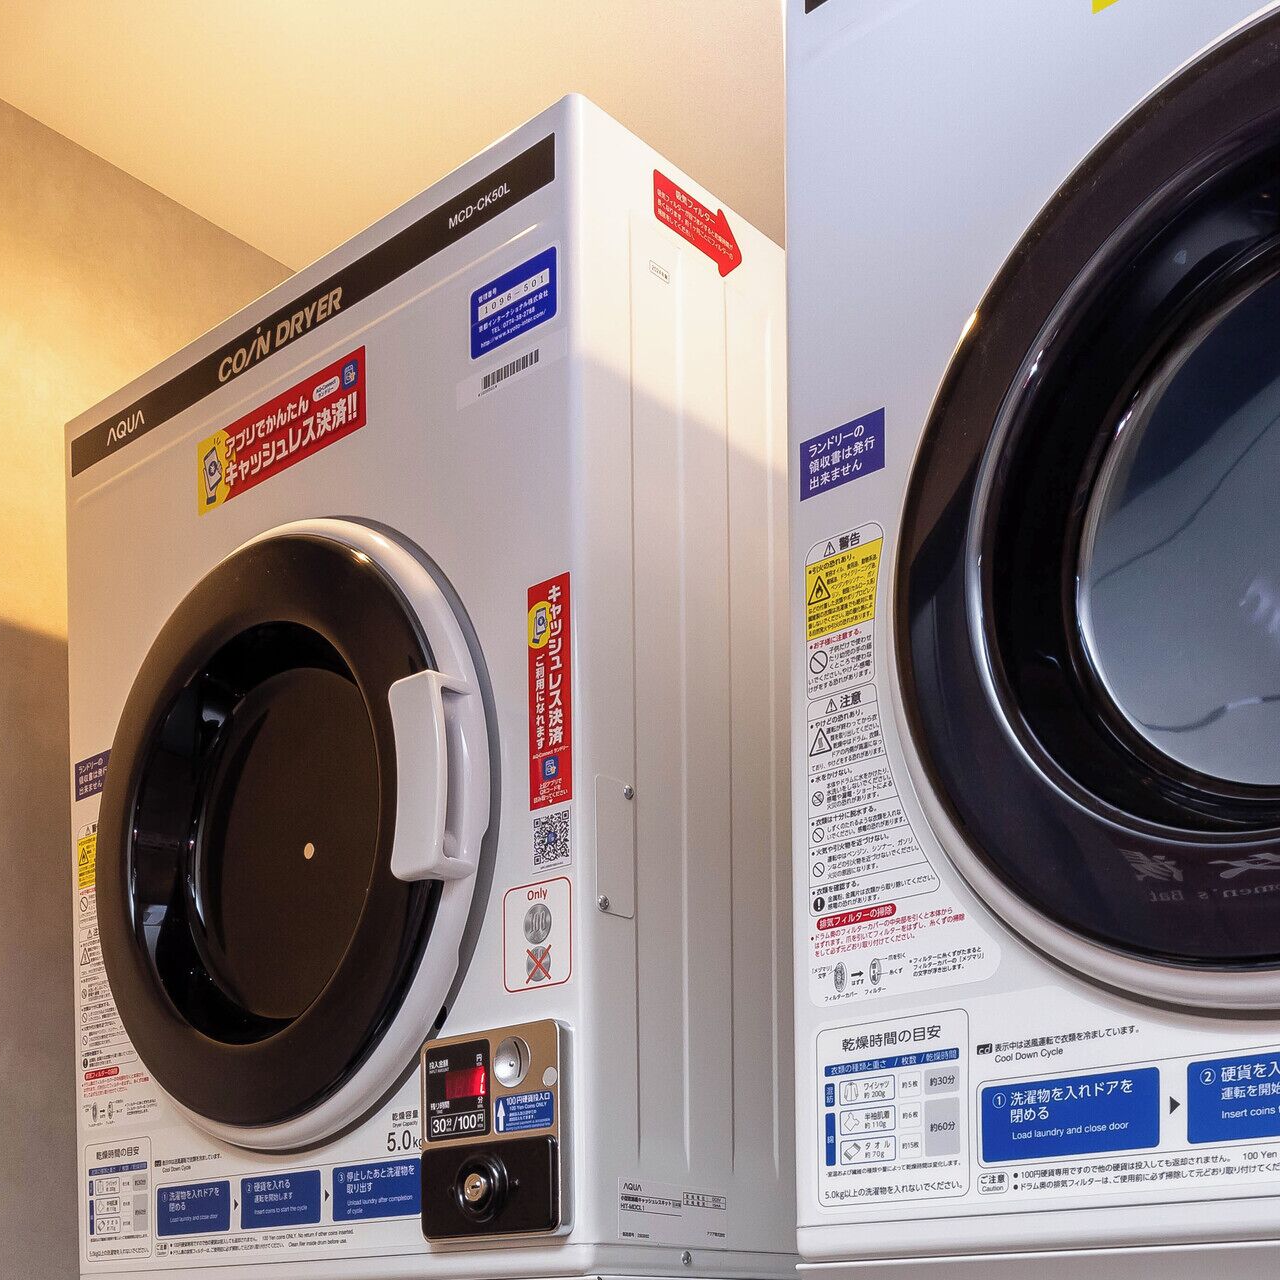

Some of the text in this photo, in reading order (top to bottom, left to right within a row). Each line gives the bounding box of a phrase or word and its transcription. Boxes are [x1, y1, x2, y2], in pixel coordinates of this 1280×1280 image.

[448, 182, 511, 230] MCD-CK50L
[276, 286, 343, 348] DRYER
[107, 410, 144, 446] AQUA
[226, 396, 309, 456] アプリでかんたん
[809, 425, 864, 457] ランドリーの
[809, 436, 875, 474] 領収書は発行
[809, 459, 863, 490] 出来ません
[839, 532, 860, 550] 警告
[548, 584, 564, 746] キャッシュレス決済
[535, 653, 545, 750] ご利用になれます
[840, 691, 861, 708] 注意
[527, 888, 548, 900] Only
[842, 1025, 941, 1052] 乾燥時間の目安
[995, 1047, 1064, 1063] Cool Down Cycle
[930, 1075, 955, 1086] 約30分
[1010, 1079, 1133, 1107] 洗濯物を入れドアを
[392, 1110, 418, 1121] 乾燥容量
[1010, 1107, 1049, 1124] 閉める
[1221, 1108, 1247, 1119] Insert
[1250, 1106, 1276, 1117] coins
[930, 1121, 955, 1132] 約60分
[1012, 1121, 1129, 1140] Load laundry and close door
[254, 1179, 291, 1192] 硬貨を入れる
[980, 1175, 1005, 1185] ご注意
